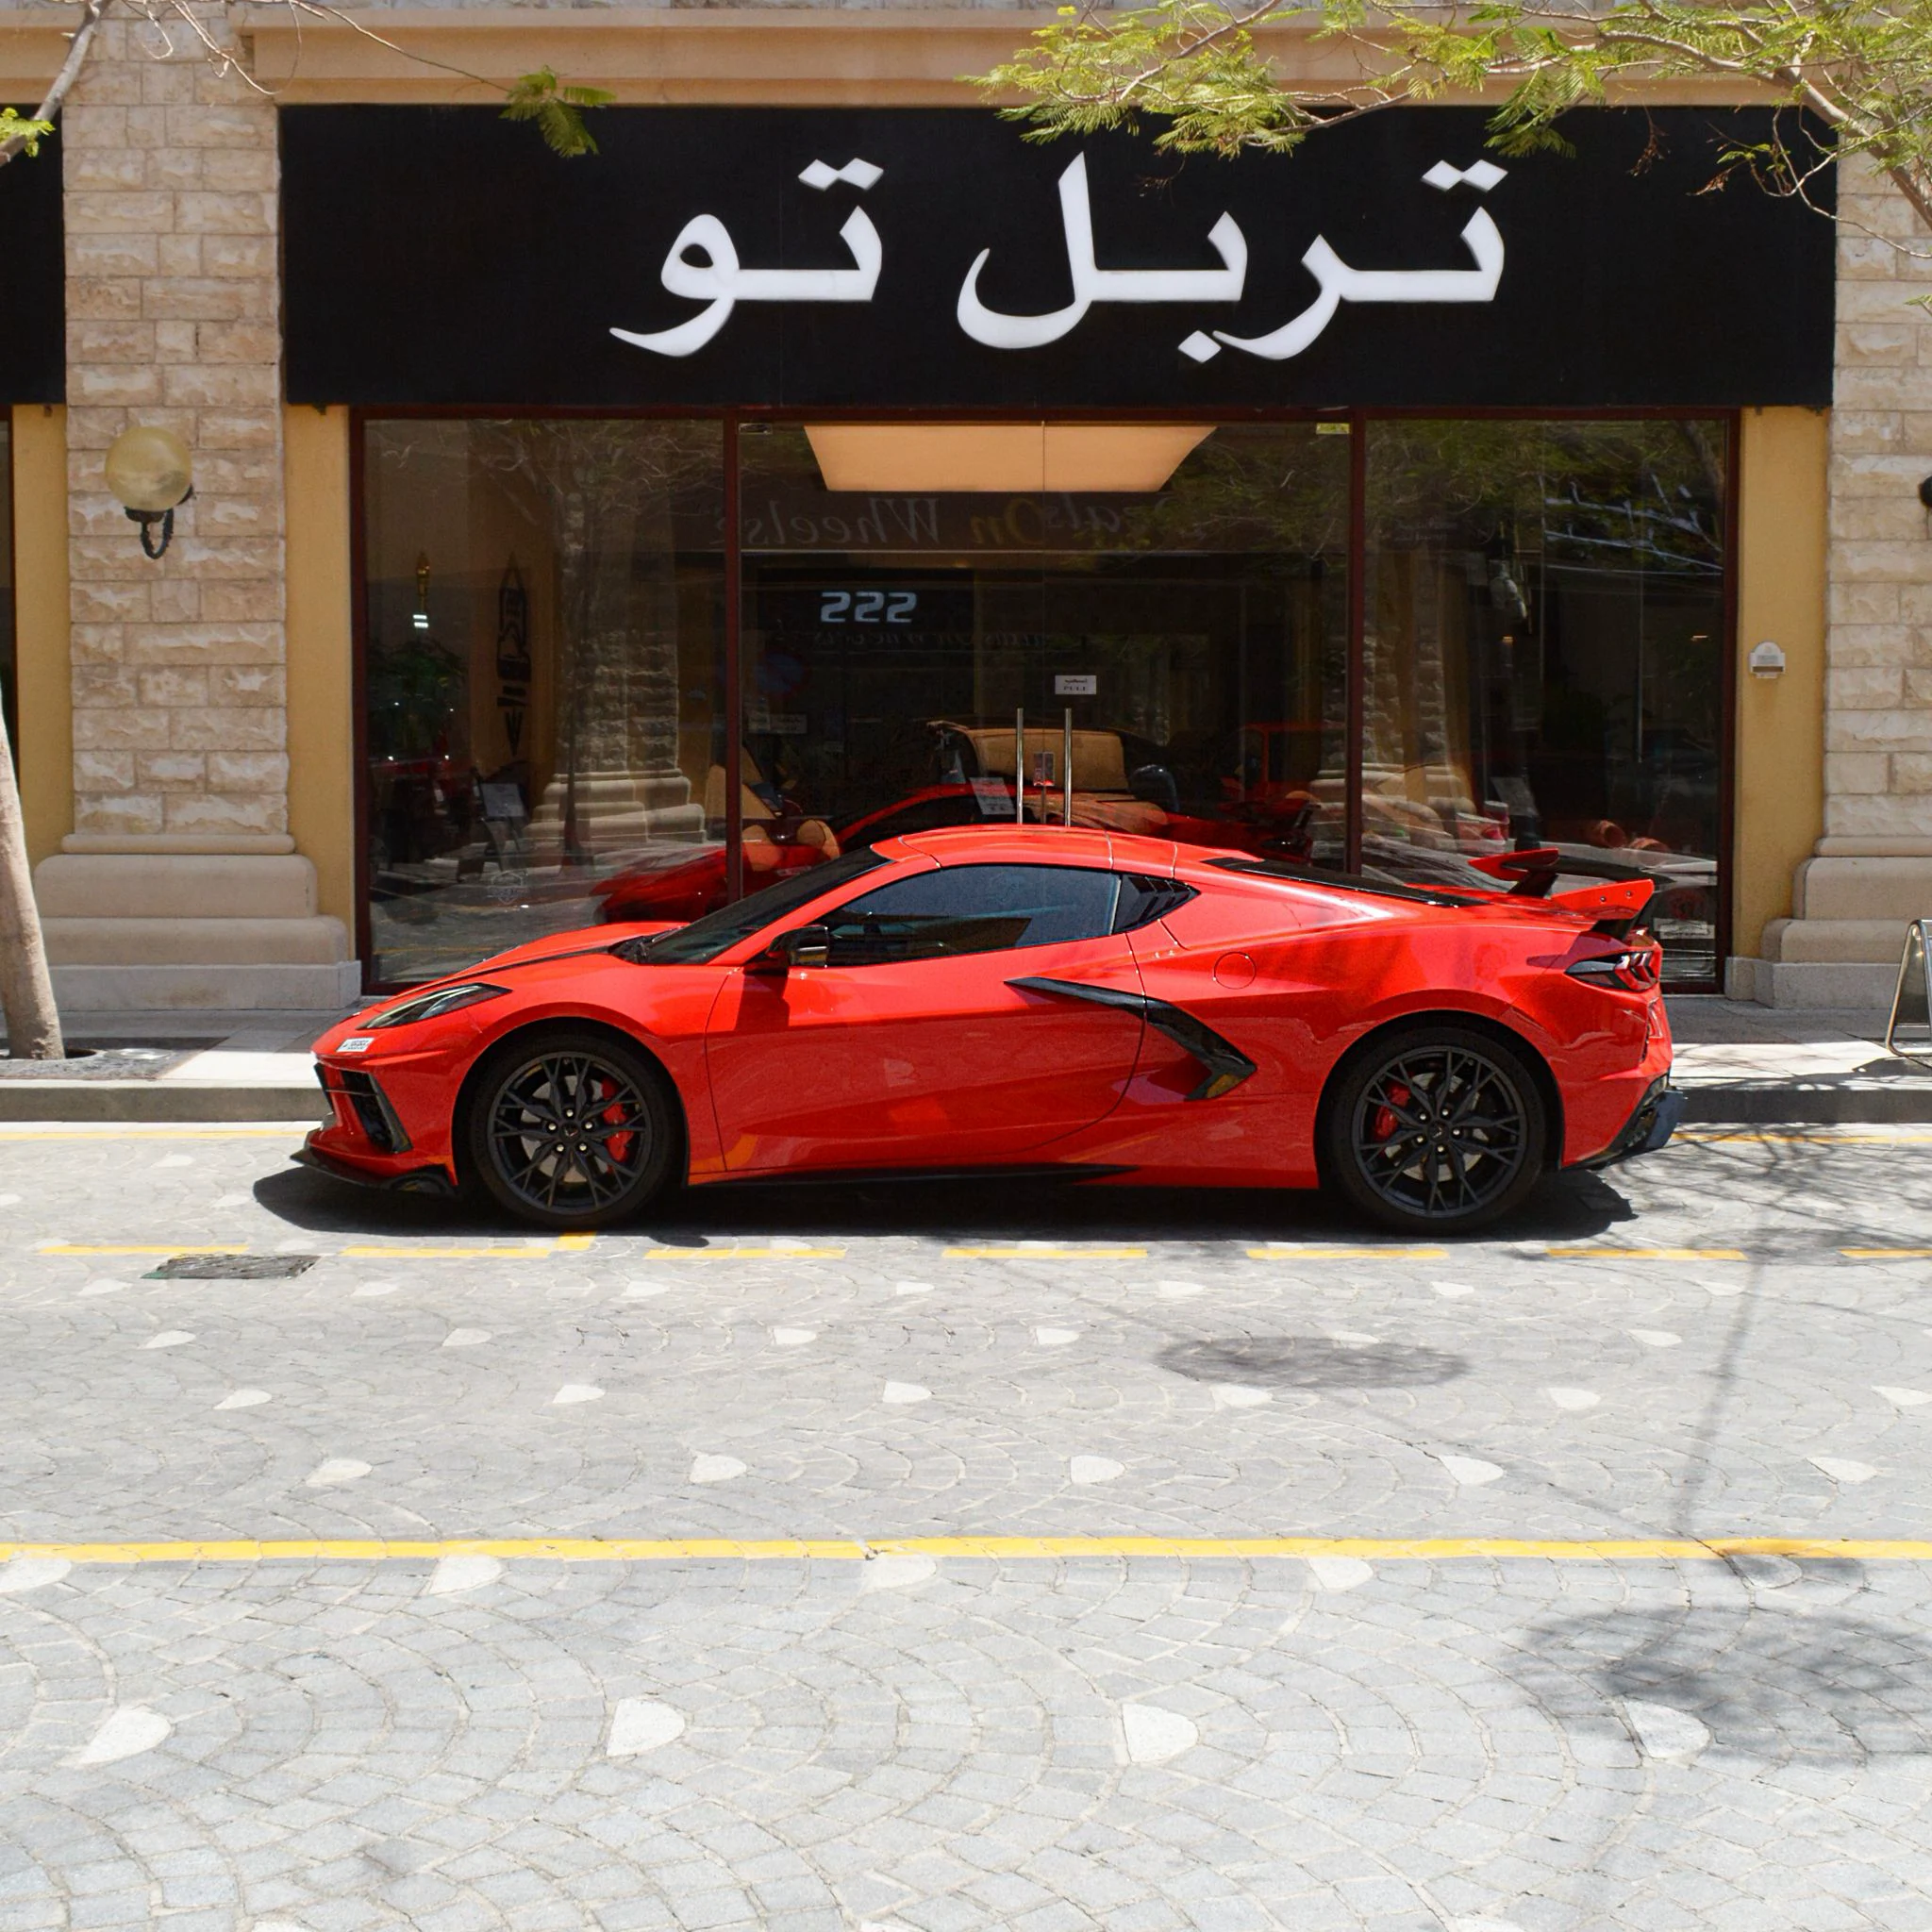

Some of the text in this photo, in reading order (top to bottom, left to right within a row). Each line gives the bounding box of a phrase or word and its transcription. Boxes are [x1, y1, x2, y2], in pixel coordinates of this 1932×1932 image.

[609, 152, 1508, 363] تربل تو
[820, 591, 917, 623] 222
